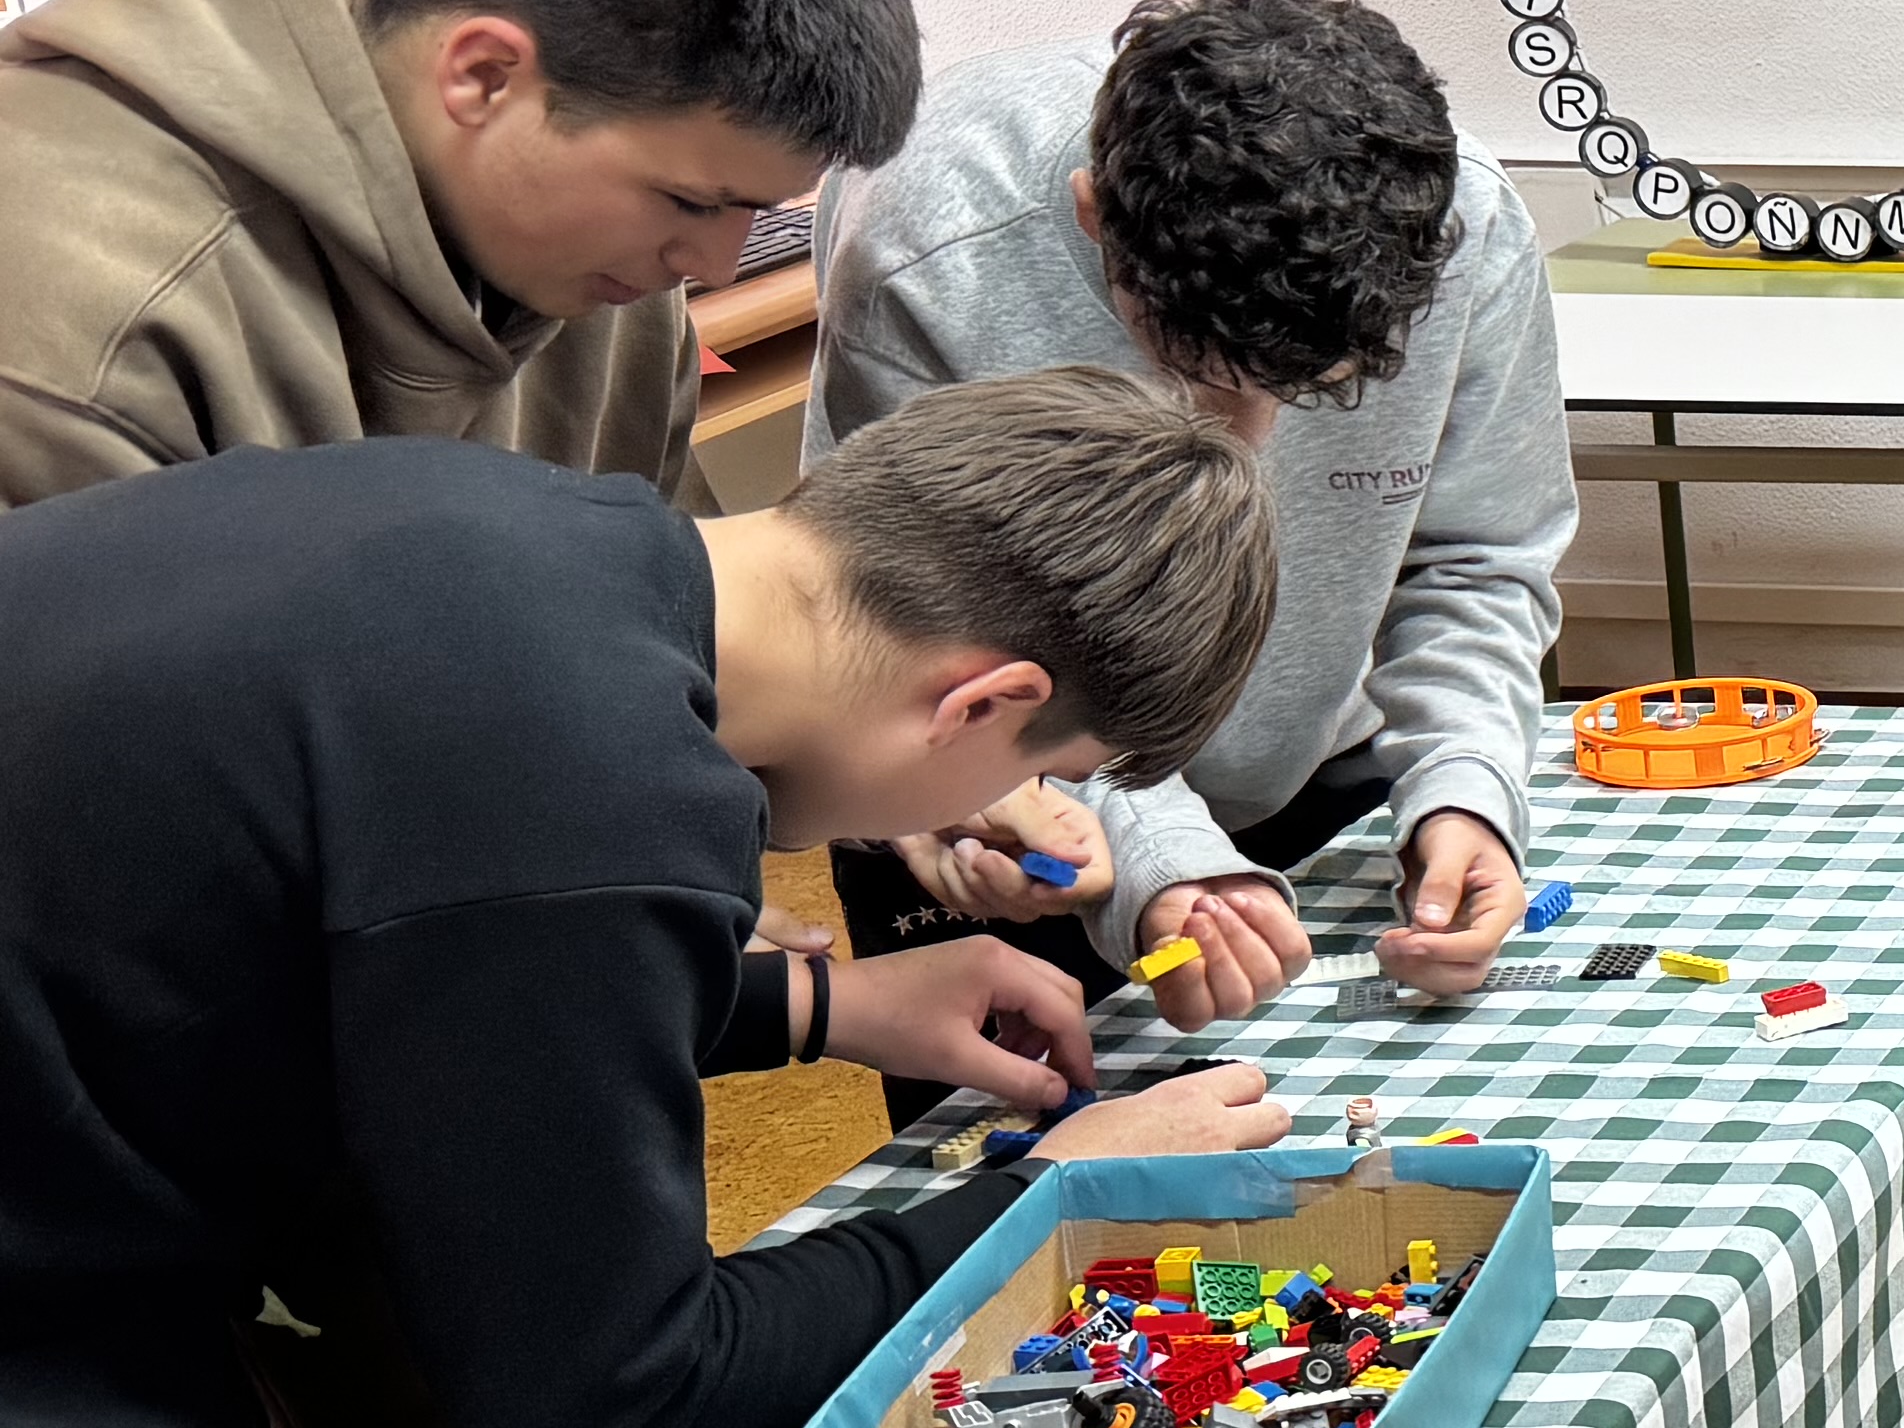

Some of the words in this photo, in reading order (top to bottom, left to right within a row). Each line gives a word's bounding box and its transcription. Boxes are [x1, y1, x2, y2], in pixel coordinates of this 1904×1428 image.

[1525, 32, 1556, 67] S
[1557, 85, 1588, 120] R
[1596, 130, 1629, 167] Q
[1652, 172, 1679, 205] P
[1704, 200, 1736, 235] O
[1767, 200, 1796, 242] Ñ
[1831, 213, 1861, 250] N
[1328, 471, 1382, 491] CITY
[1390, 463, 1432, 489] RU
